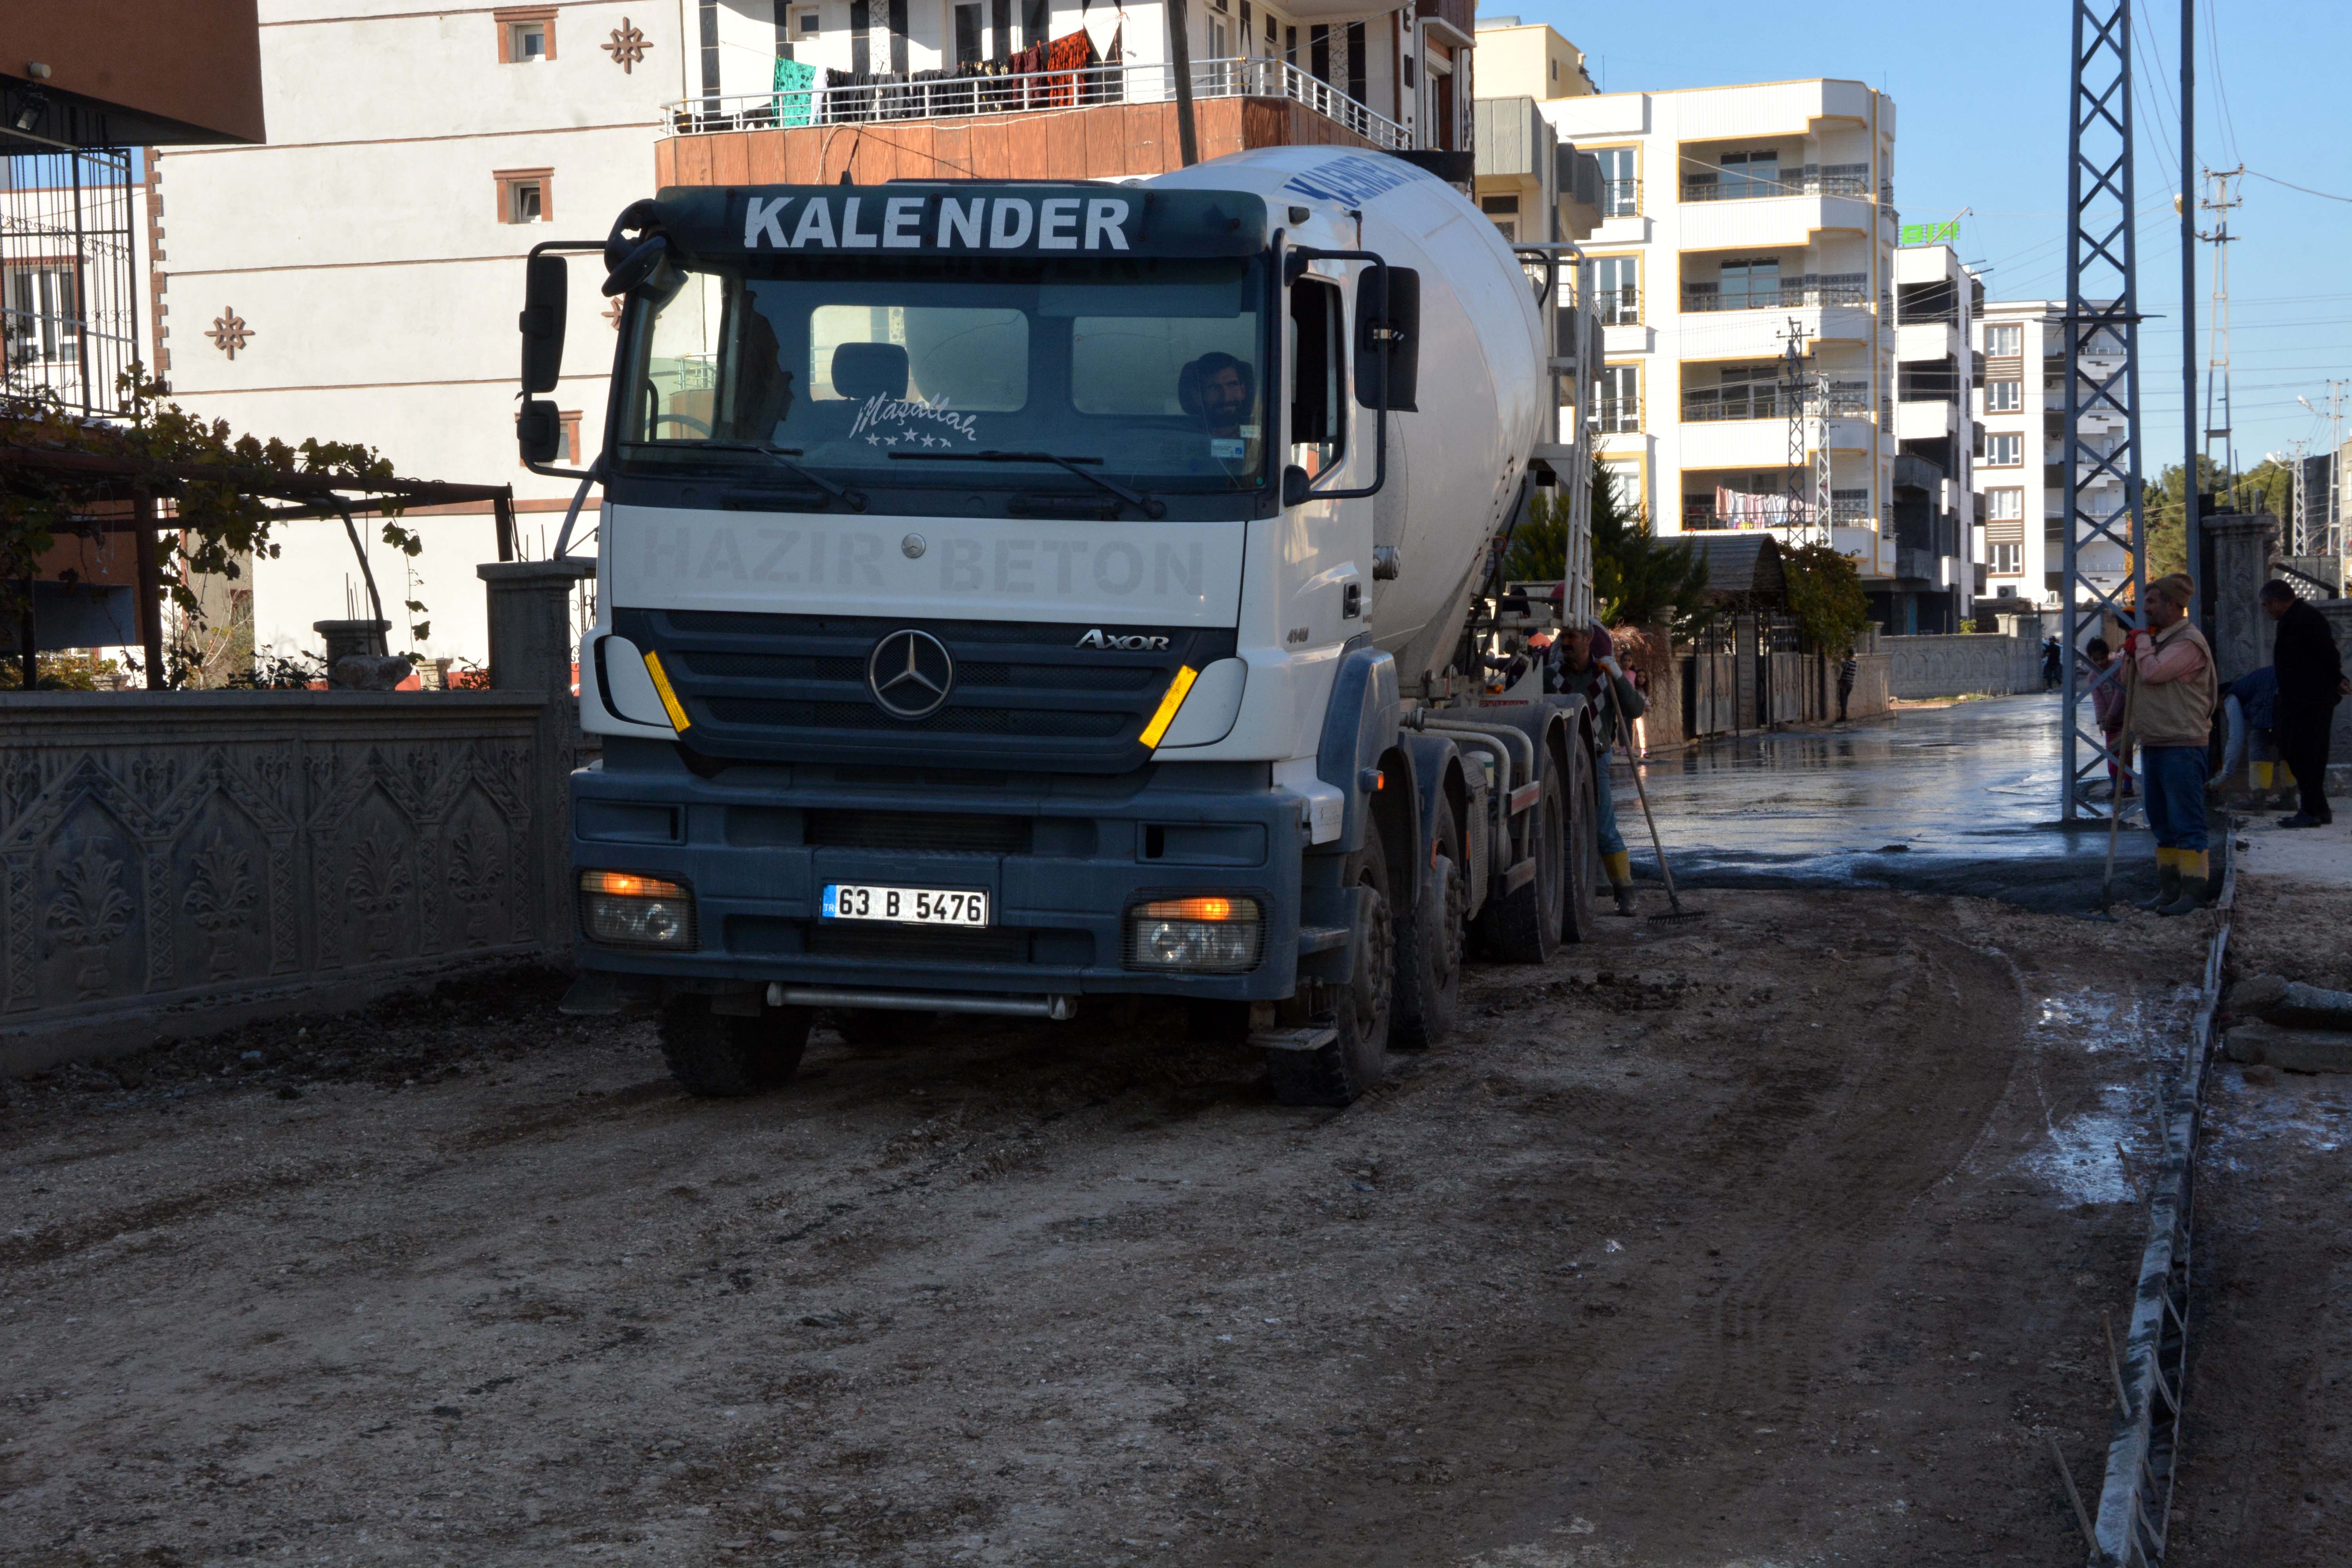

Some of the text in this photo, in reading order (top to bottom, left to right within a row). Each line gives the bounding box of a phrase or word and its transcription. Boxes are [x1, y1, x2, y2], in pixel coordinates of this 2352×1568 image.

[744, 197, 1130, 250] KALENDER
[849, 391, 977, 441] Maşallah
[642, 526, 1203, 595] HAZIR BETON
[823, 889, 981, 922] TR 63 B 5476
